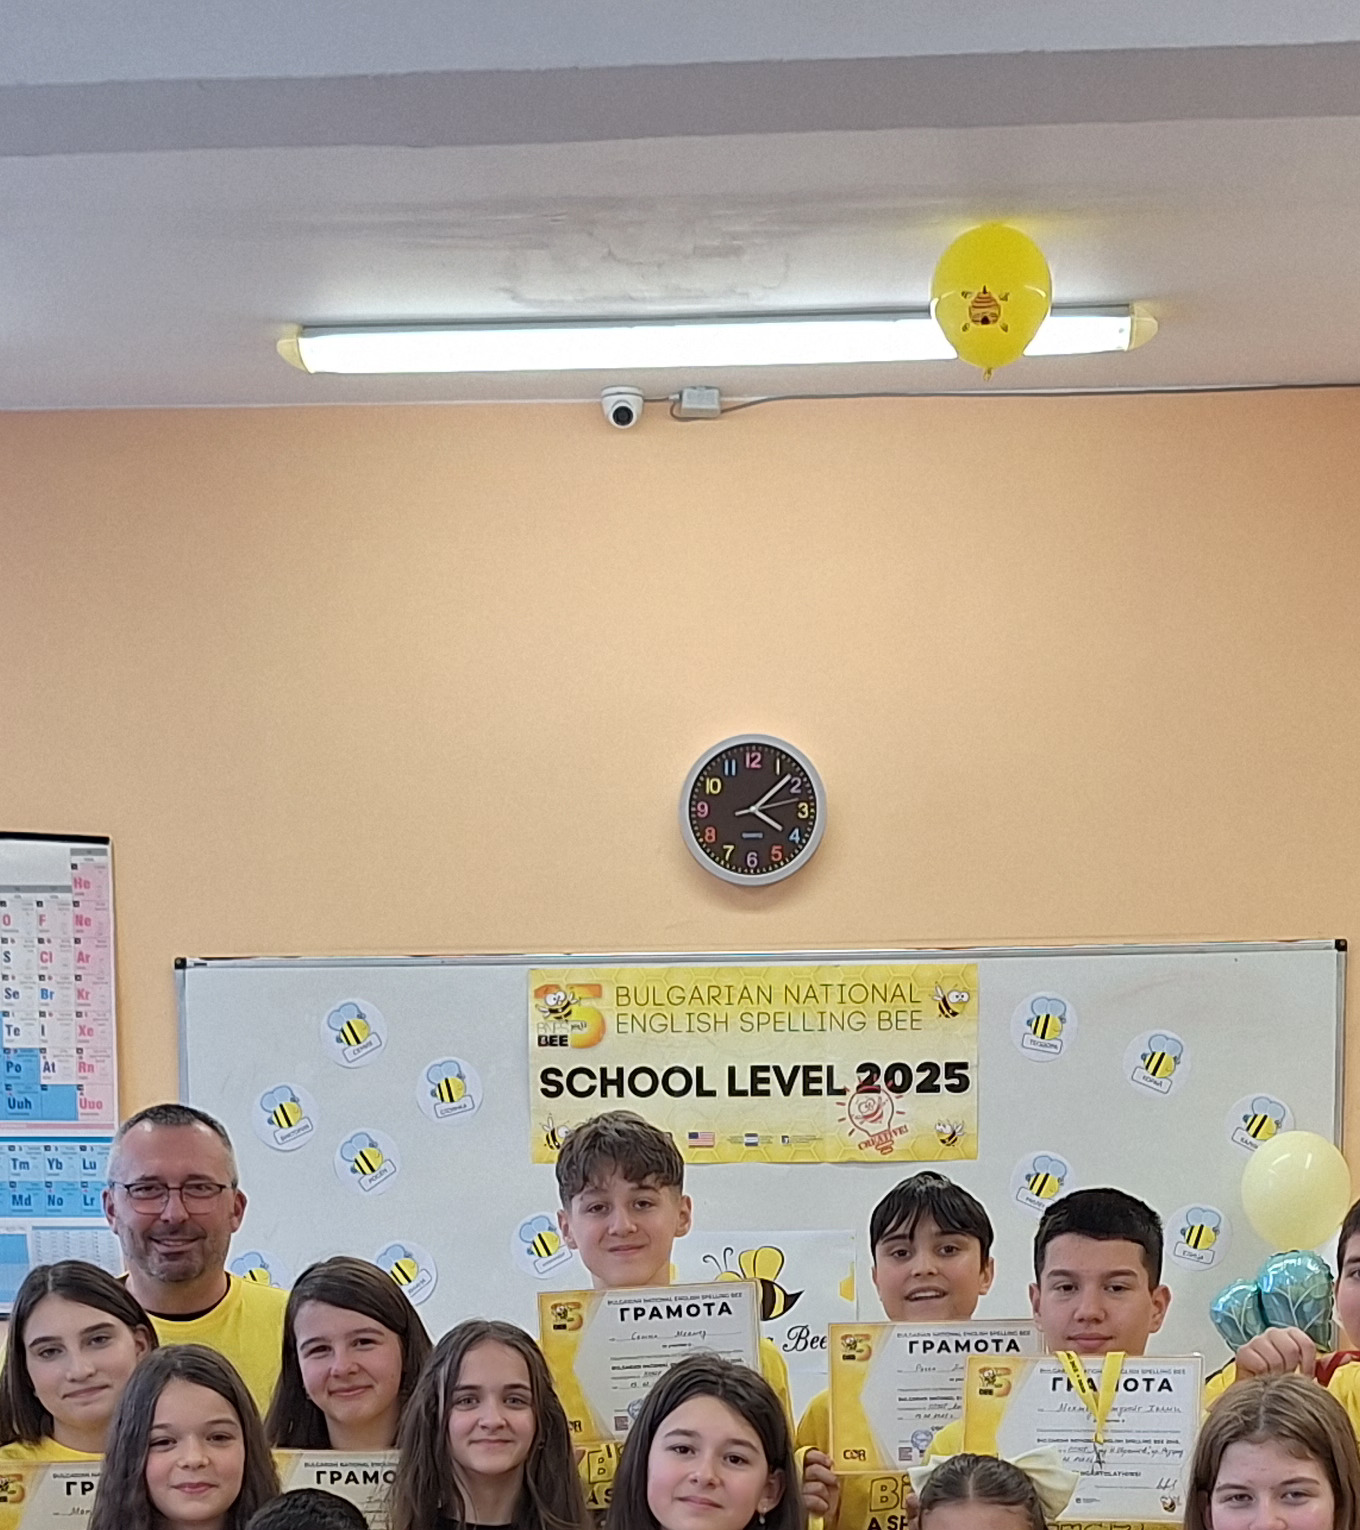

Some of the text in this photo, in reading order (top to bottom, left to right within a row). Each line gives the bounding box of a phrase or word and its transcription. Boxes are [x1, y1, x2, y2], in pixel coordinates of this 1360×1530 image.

[724, 759, 736, 776] 11
[746, 752, 761, 768] 12
[776, 758, 780, 775] 1
[706, 778, 721, 794] 10
[790, 777, 801, 793] 2
[697, 801, 708, 818] 9
[798, 802, 809, 818] 3
[705, 827, 716, 843] 8
[789, 828, 800, 843] 4
[723, 845, 735, 860] 7
[746, 852, 758, 868] 6
[771, 846, 782, 861] 5
[74, 879, 90, 889] He
[3, 914, 11, 925] O
[40, 914, 46, 925] F
[75, 915, 91, 926] Ne
[3, 952, 11, 963] S
[40, 952, 52, 963] Cl
[77, 952, 91, 963] Ar
[4, 988, 20, 1000] Se
[41, 988, 54, 1000] Br
[77, 988, 90, 1000] Kr
[616, 983, 922, 1007] BULGARIAN NATIONAL
[617, 1010, 922, 1034] ENGLISH SPELLING BEE
[5, 1025, 20, 1036] Te
[41, 1025, 45, 1036] I
[538, 1035, 568, 1047] BEE
[43, 1061, 56, 1073] At
[540, 1062, 970, 1098] SCHOOL LEVEL 2025
[48, 1159, 63, 1170] Yb
[83, 1159, 96, 1170] Lu
[620, 1302, 732, 1322] ГРАМОТА
[908, 1339, 1020, 1354] ГРАМОТА
[1052, 1377, 1173, 1392] ГРАОТА
[316, 1470, 396, 1484] ГРАМО
